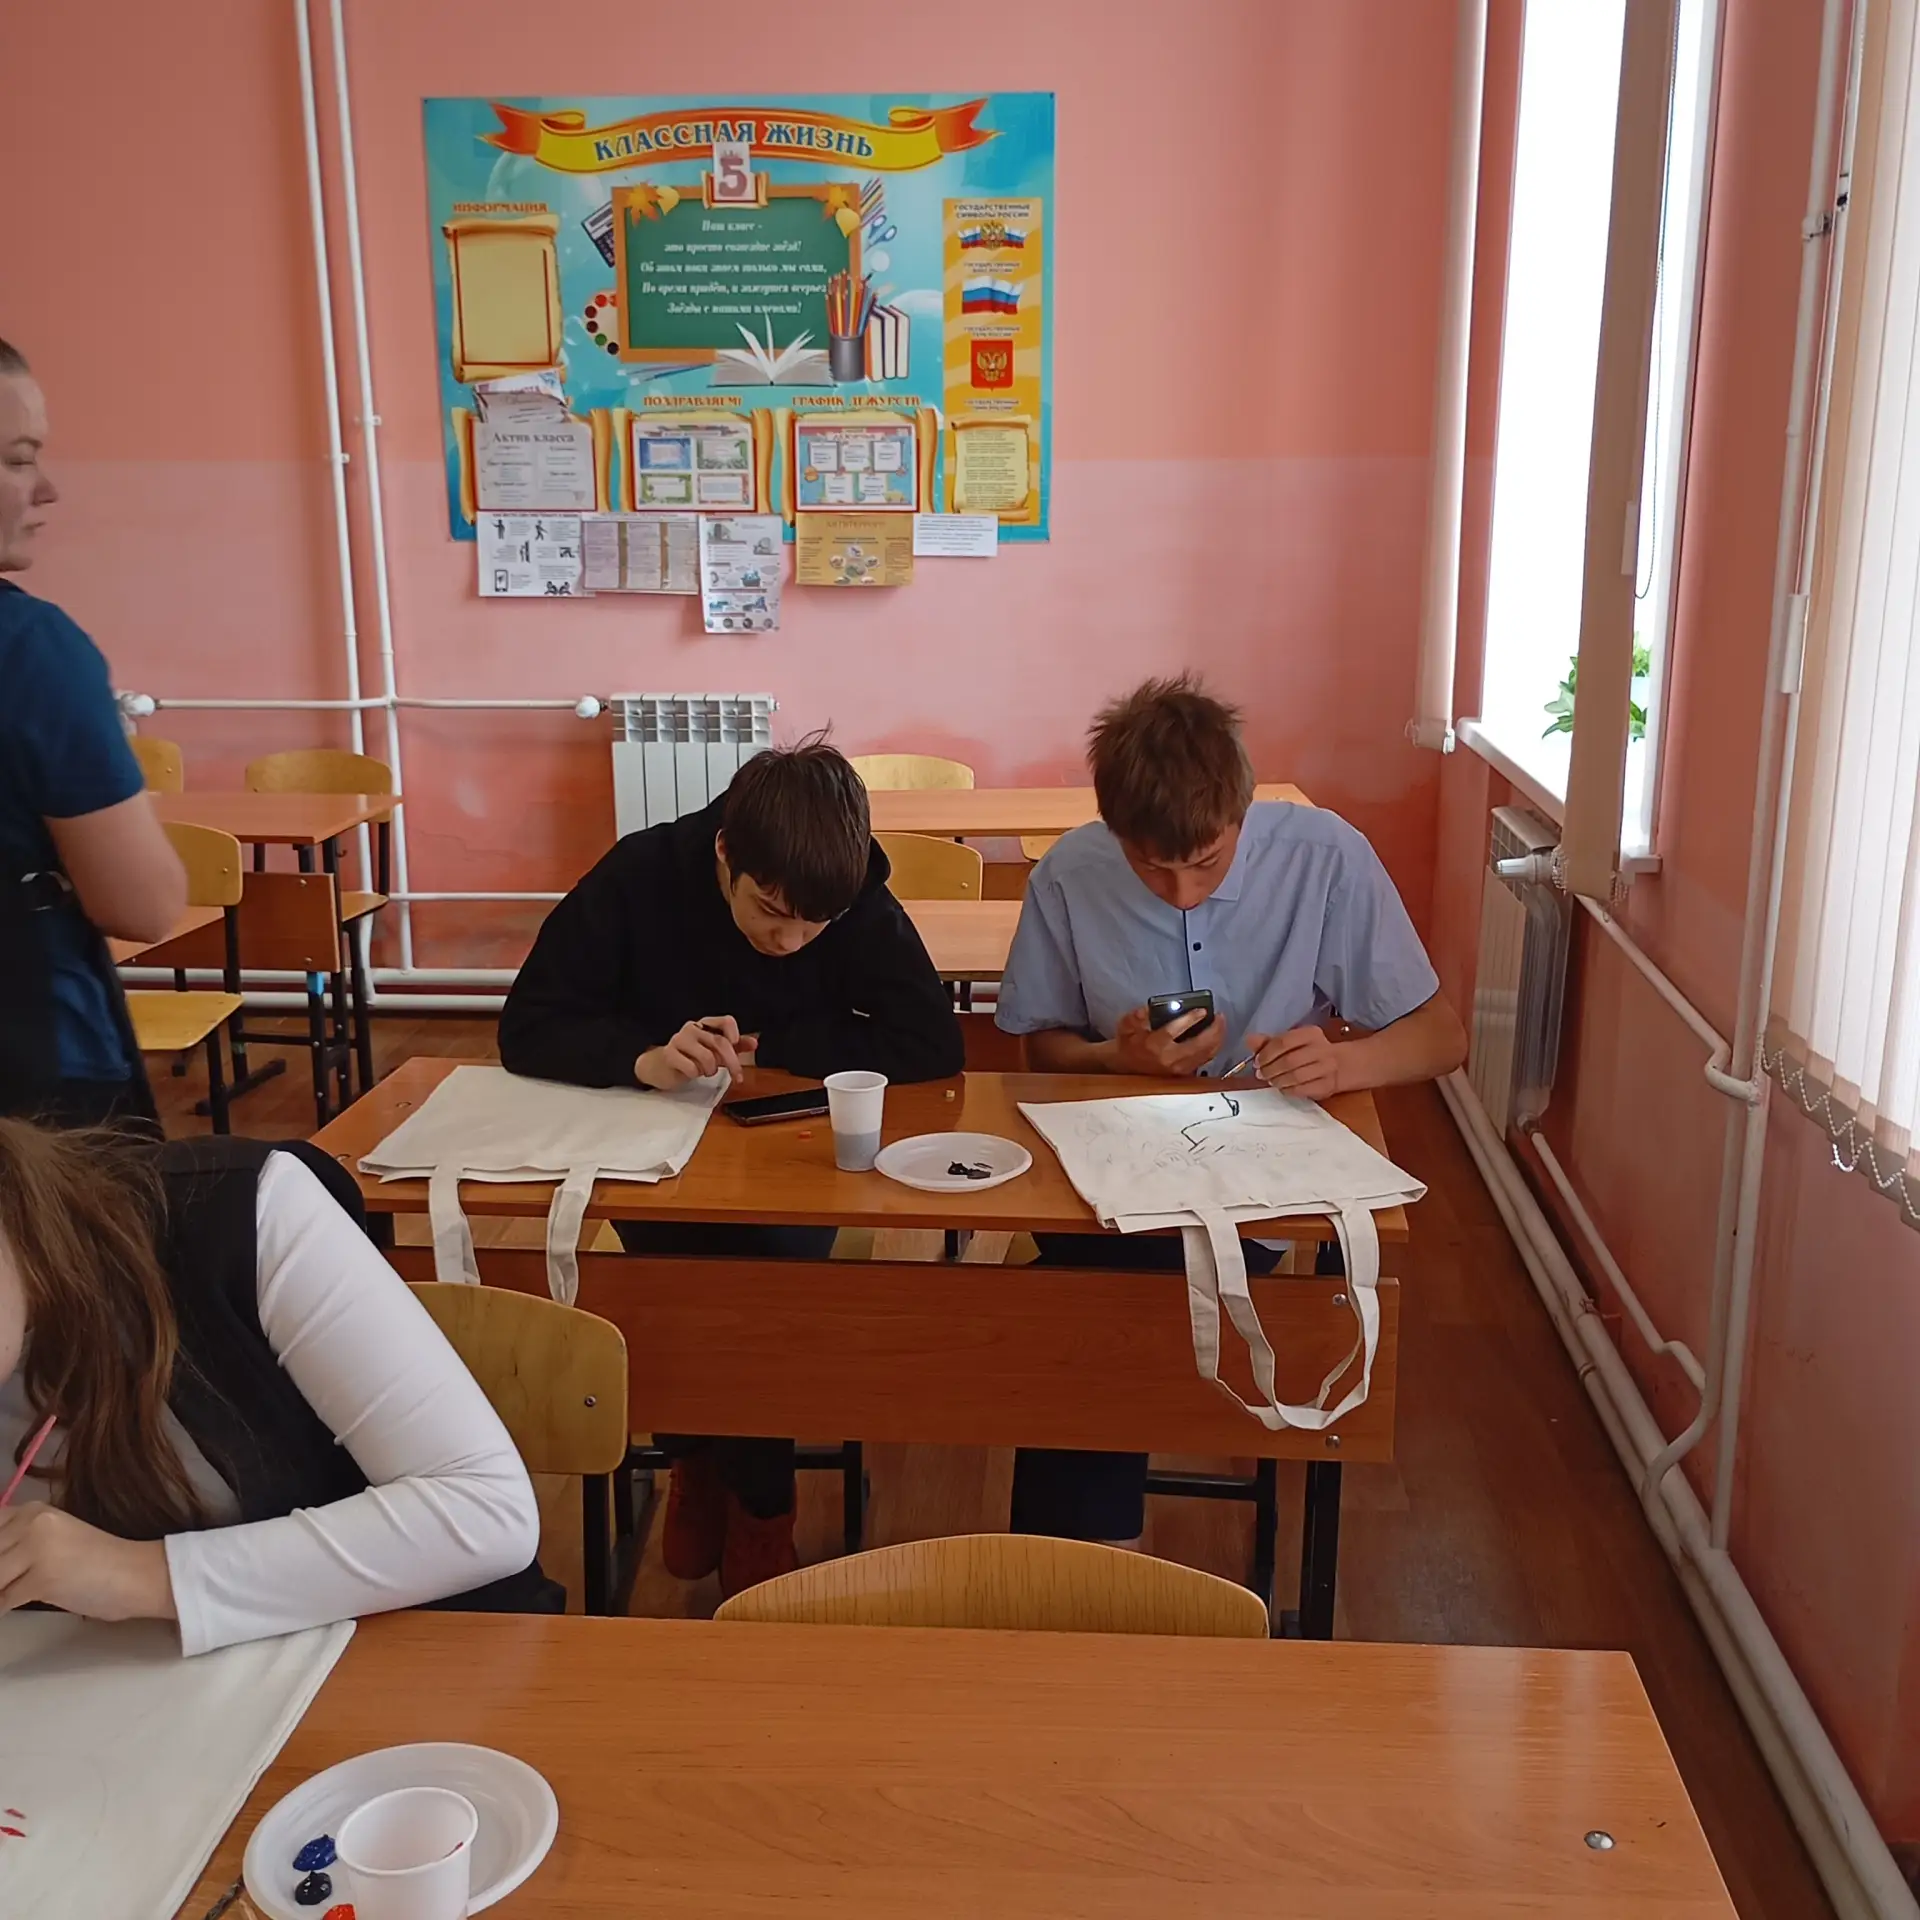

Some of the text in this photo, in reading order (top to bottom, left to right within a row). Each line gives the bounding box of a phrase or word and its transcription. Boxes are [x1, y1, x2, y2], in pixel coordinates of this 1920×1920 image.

[594, 120, 874, 161] КЛАССНАЯ ЖИЗНЬ
[718, 154, 748, 198] 5
[453, 202, 548, 213] ИНФОРМАЦИЯ
[792, 396, 844, 407] ГРАФИК
